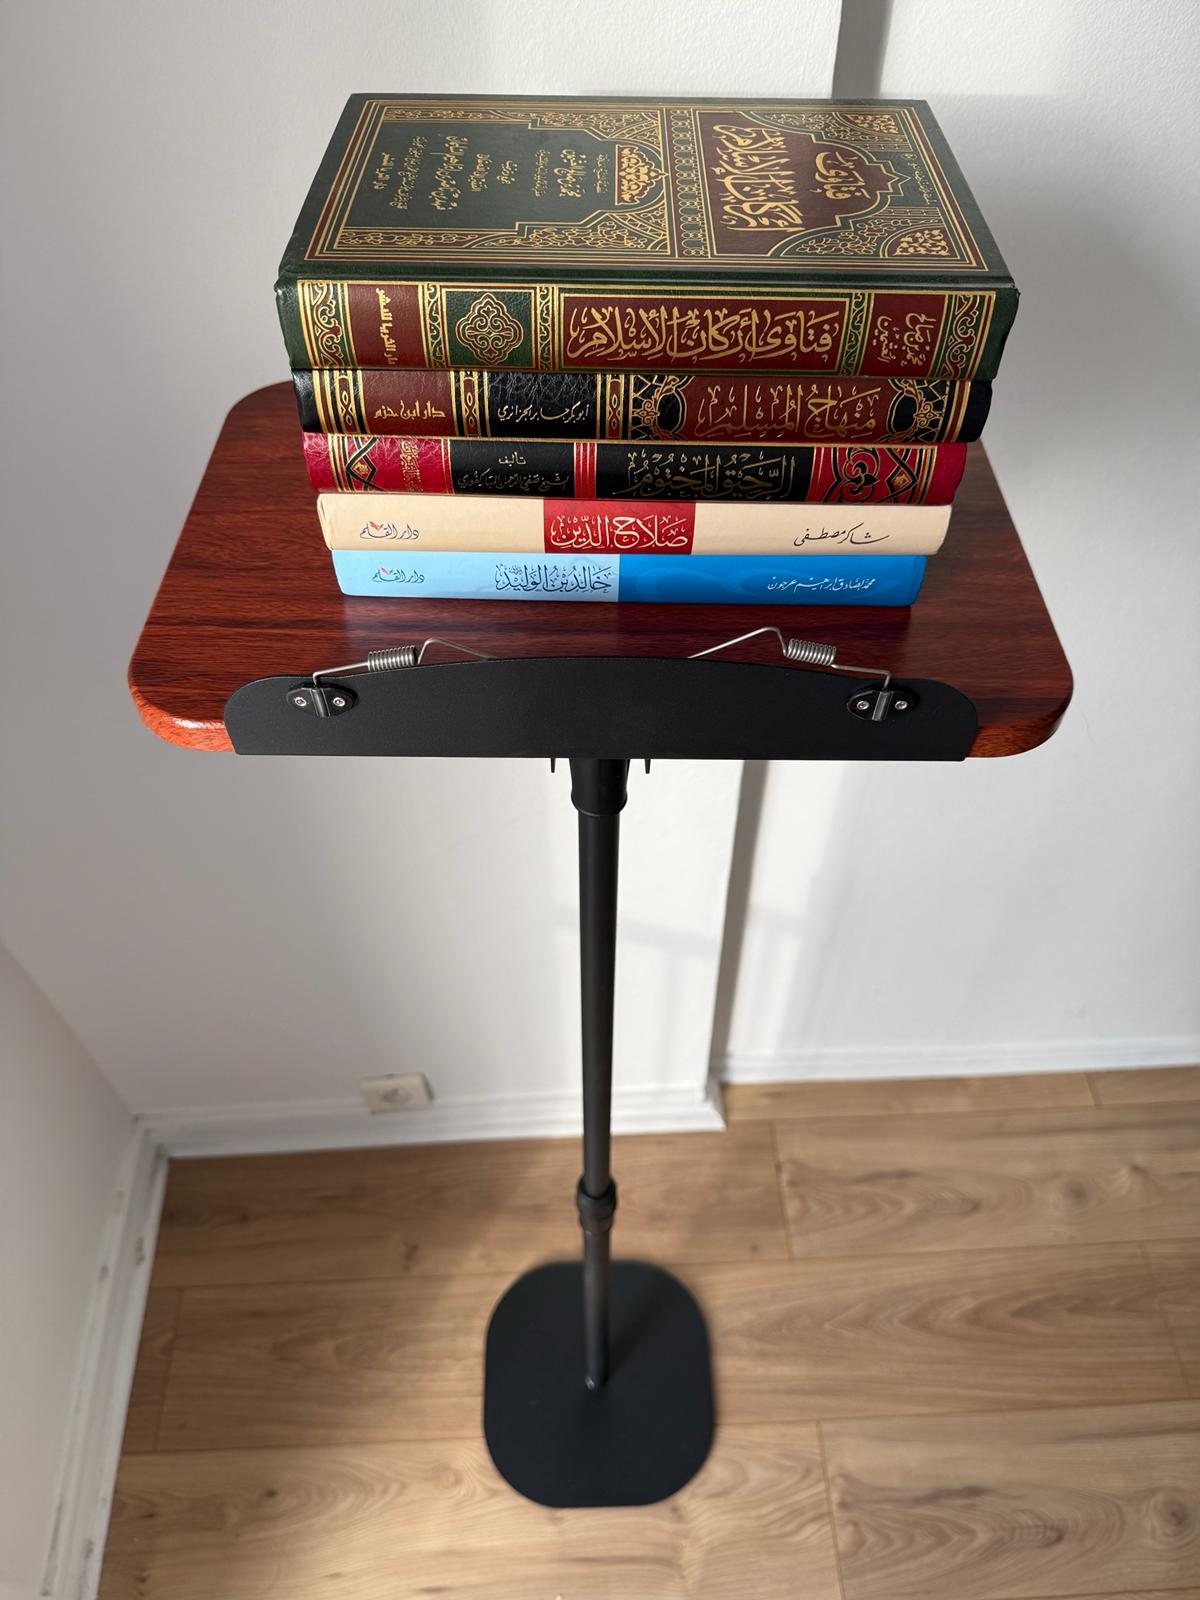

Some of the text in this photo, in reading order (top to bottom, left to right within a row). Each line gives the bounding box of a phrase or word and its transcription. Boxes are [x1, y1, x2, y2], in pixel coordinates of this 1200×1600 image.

[752, 309, 840, 362] فتاوى
[374, 400, 447, 420] دار ابن حزم
[694, 383, 882, 438] منهاج المسلم
[359, 521, 420, 540] دار القلم
[550, 515, 690, 550] صلاح الدين
[837, 522, 890, 545] شاكر
[371, 567, 426, 584] دار القلم
[495, 564, 548, 592] الوليد
[565, 565, 612, 593] خالد
